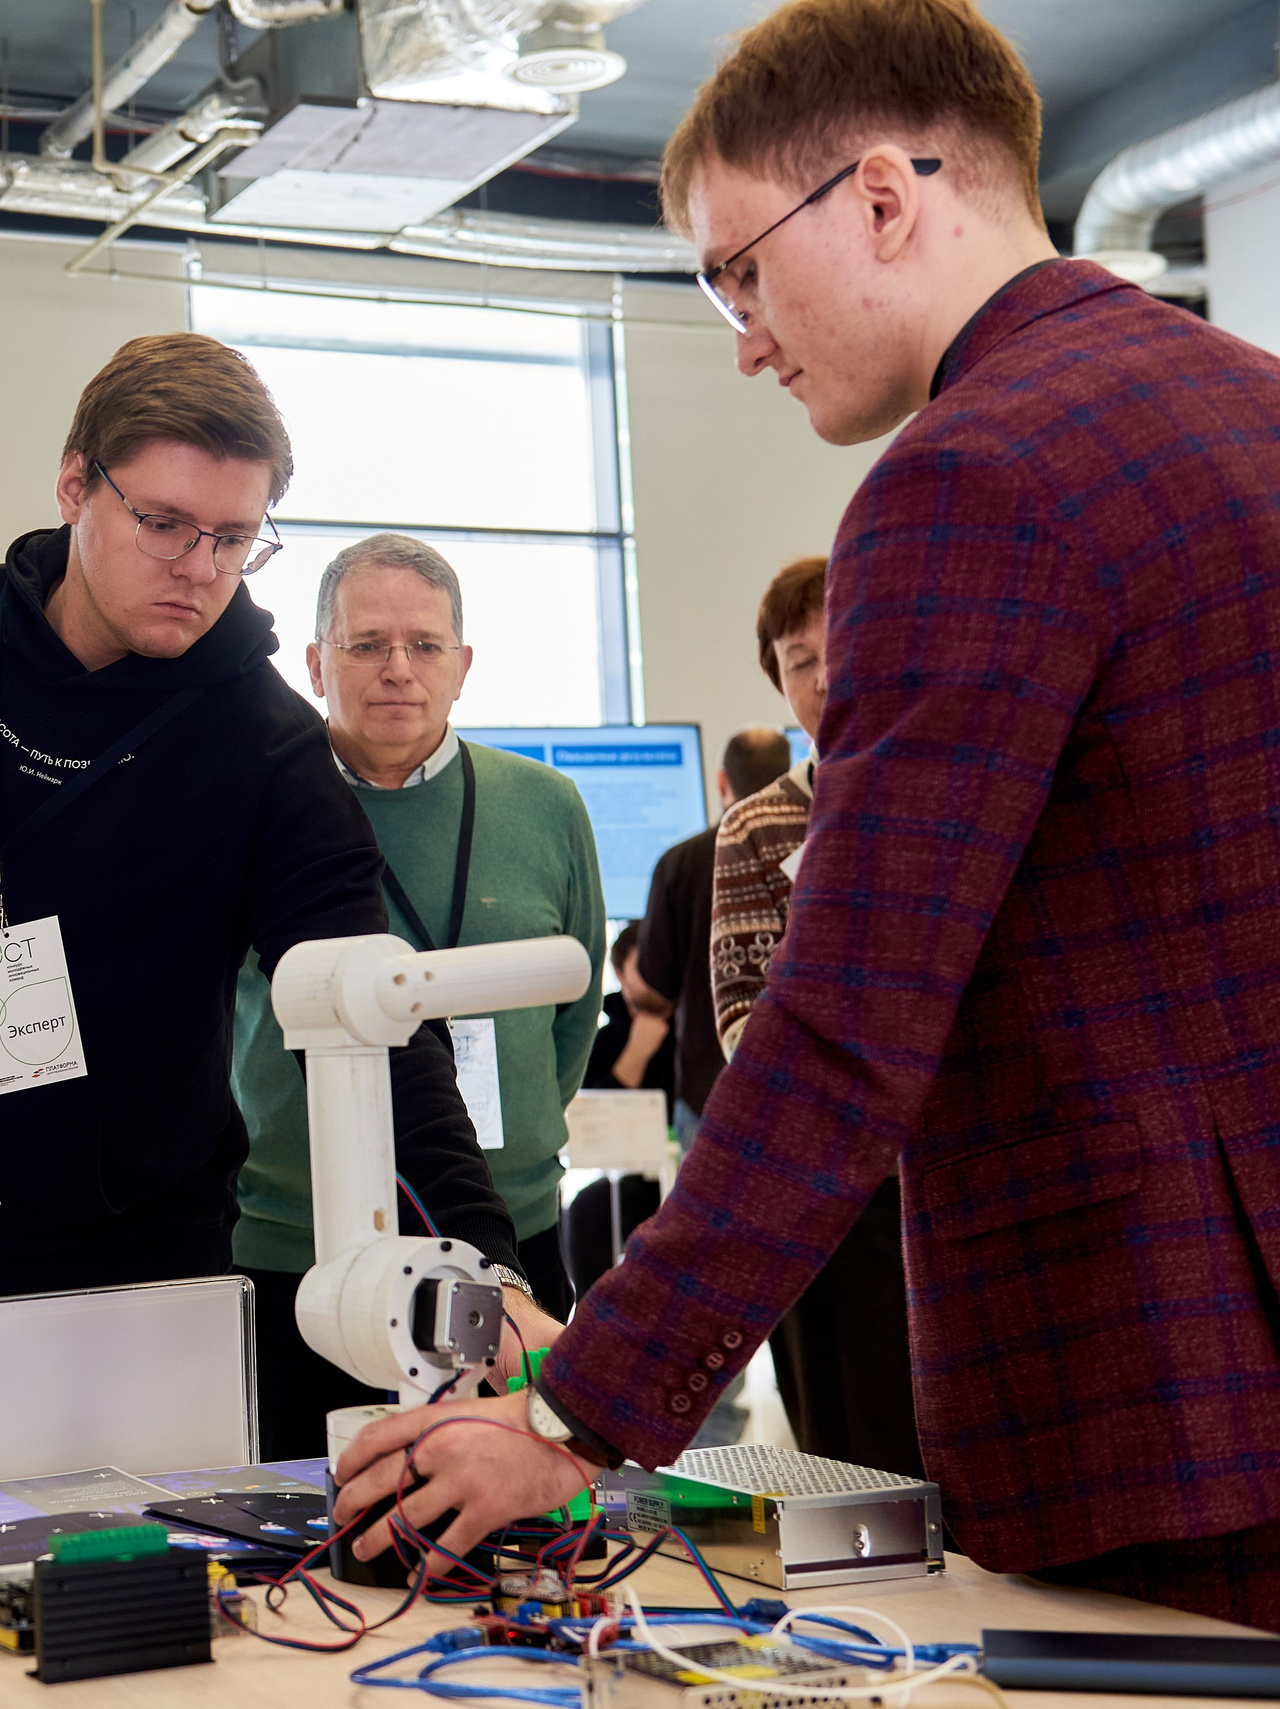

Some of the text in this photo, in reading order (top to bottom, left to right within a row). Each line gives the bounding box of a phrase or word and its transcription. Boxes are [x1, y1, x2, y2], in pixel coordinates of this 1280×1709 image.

[30, 749, 54, 765] ПУТЬ
[54, 757, 63, 767] К
[7, 1016, 66, 1039] Эксперт
[45, 1060, 78, 1072] ПЛАТФОРМА
